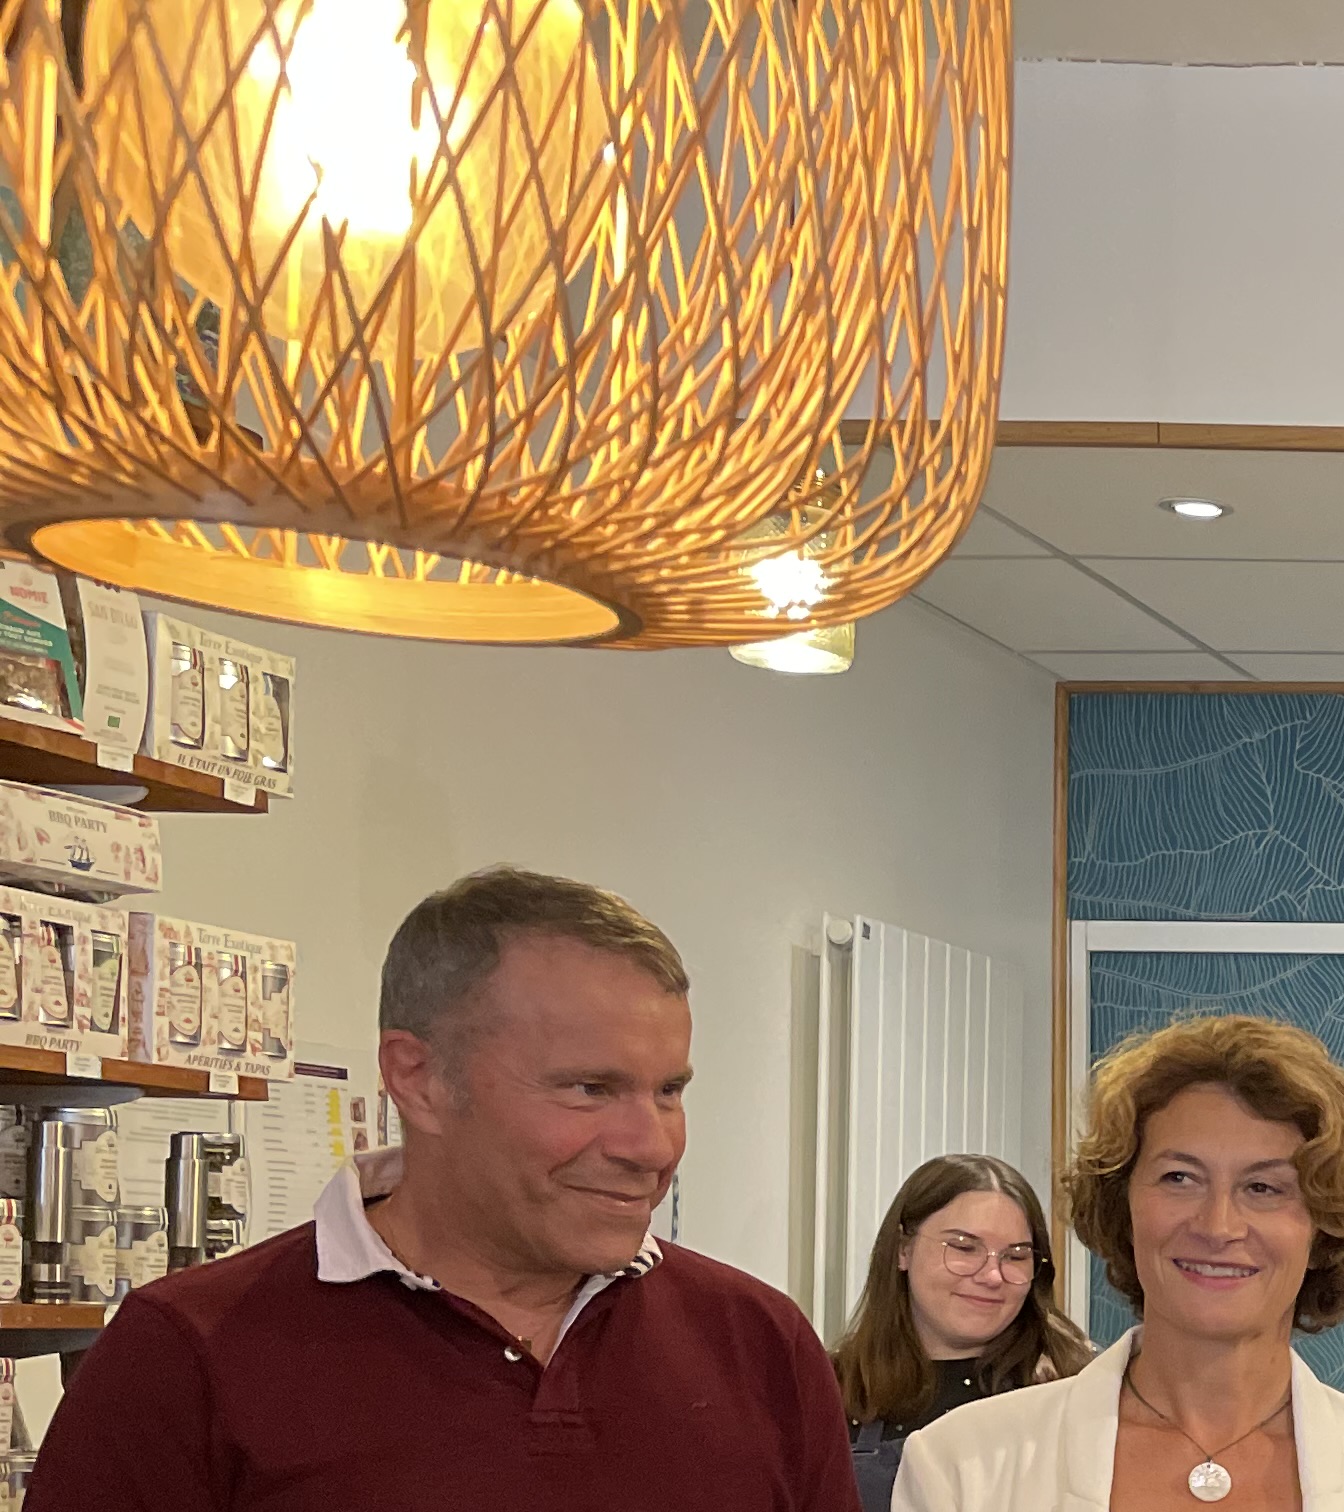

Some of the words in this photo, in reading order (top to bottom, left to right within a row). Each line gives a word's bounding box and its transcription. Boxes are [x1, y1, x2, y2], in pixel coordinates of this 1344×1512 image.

[253, 774, 277, 790] GRAS
[48, 810, 72, 828] BBQ
[74, 815, 107, 834] PARTY
[197, 927, 221, 947] Terre
[25, 1033, 48, 1049] BBQ
[49, 1036, 82, 1052] PARTY
[244, 1062, 271, 1077] TAPAS
